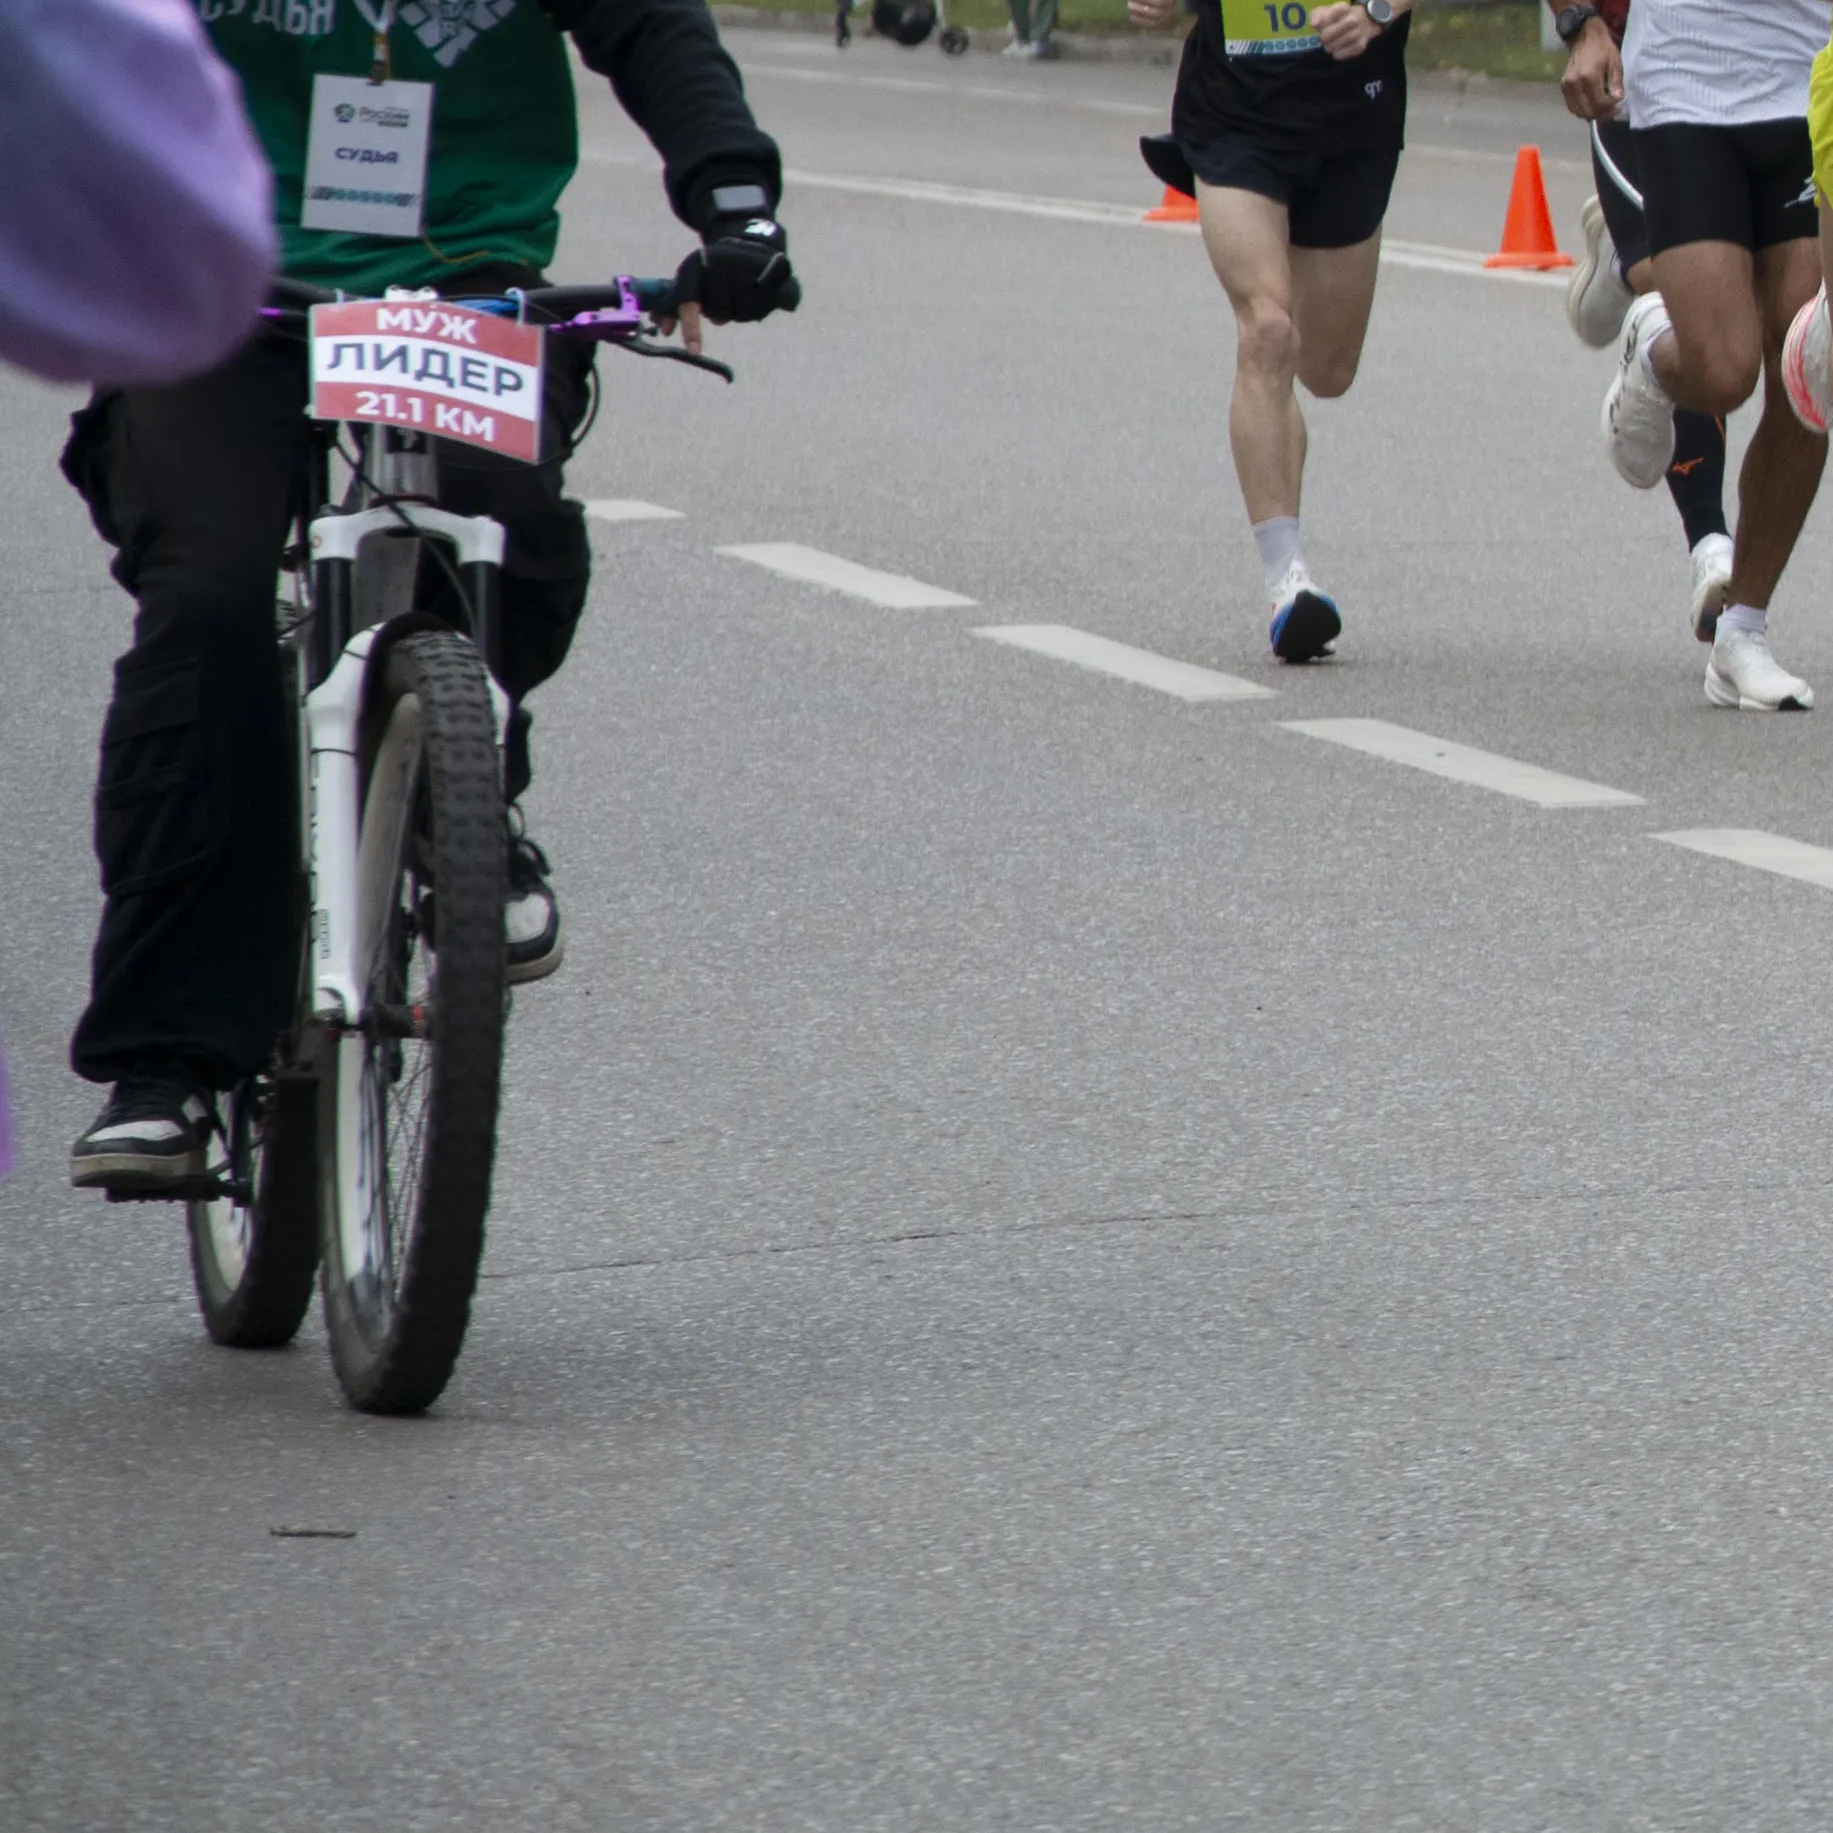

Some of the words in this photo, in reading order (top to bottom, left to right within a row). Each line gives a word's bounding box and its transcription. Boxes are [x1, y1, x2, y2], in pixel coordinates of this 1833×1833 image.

[1263, 2, 1307, 33] 10
[334, 146, 400, 165] СУДЬЯ
[375, 306, 478, 344] МУЖ
[326, 342, 524, 397] ЛИДЕР
[354, 389, 424, 423] 21.1
[434, 402, 495, 442] КМ
